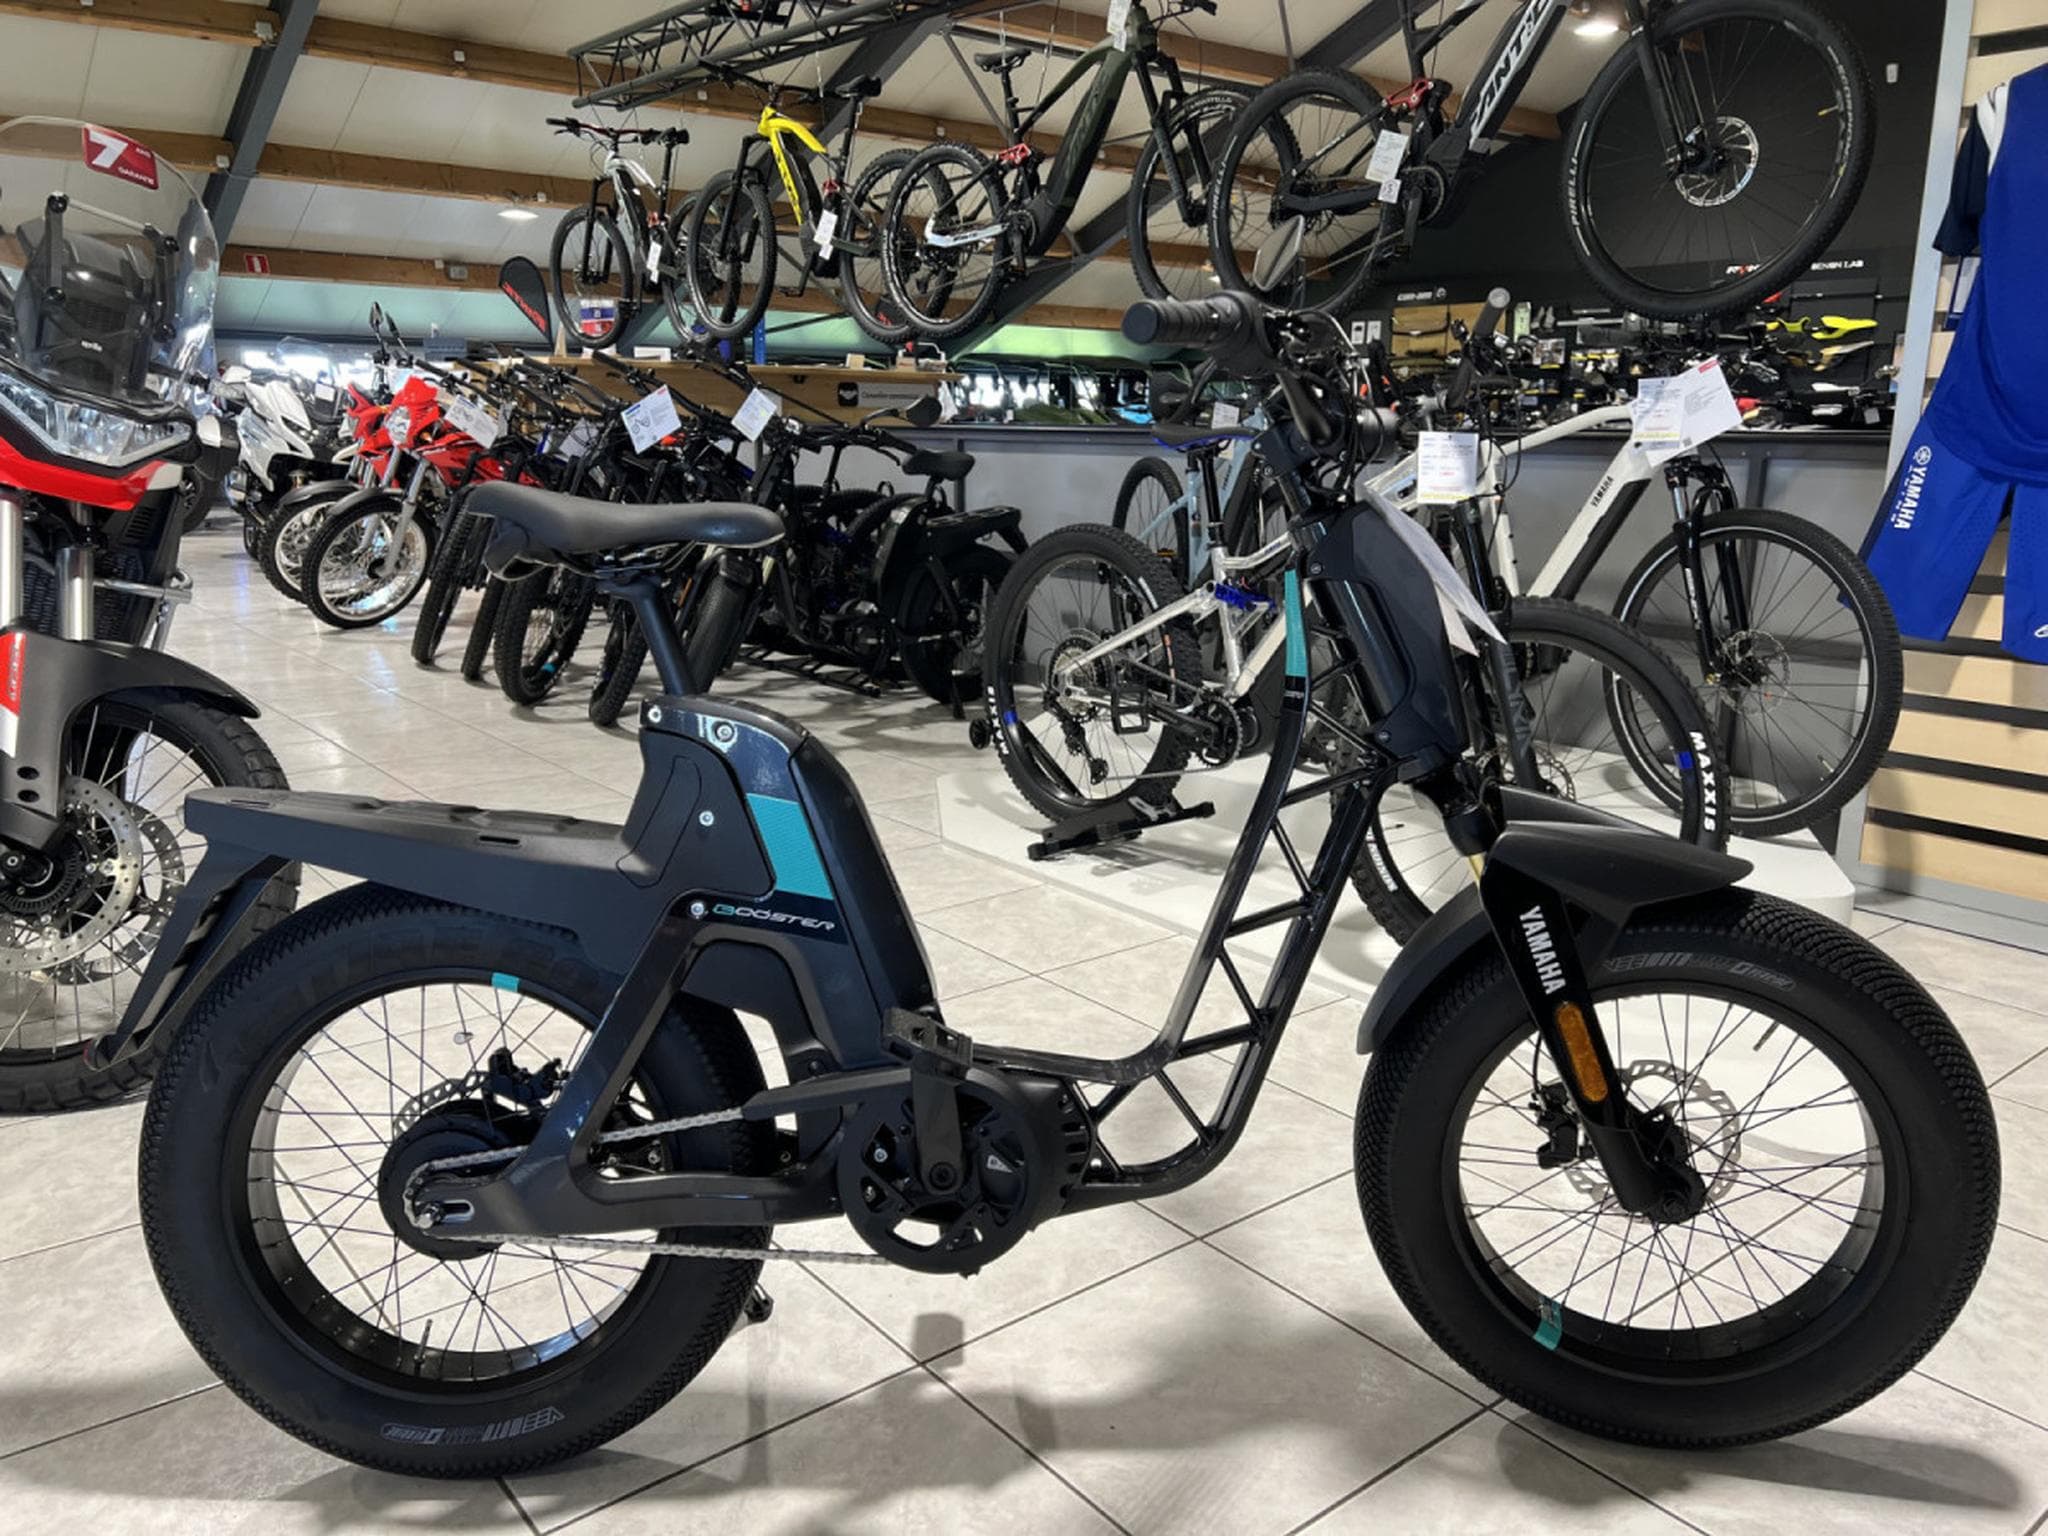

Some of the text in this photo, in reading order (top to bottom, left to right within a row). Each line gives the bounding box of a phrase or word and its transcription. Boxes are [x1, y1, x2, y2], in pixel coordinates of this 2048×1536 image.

[88, 129, 129, 169] 7
[1567, 157, 1581, 226] PIRELLI
[1590, 475, 1614, 508] YAMAHA
[1893, 466, 1928, 530] YAMAHA
[986, 685, 1010, 756] MAXXIS
[1689, 731, 1717, 832] MAXXIS
[712, 903, 836, 931] BOOSTER
[1520, 905, 1566, 995] YAMAHA
